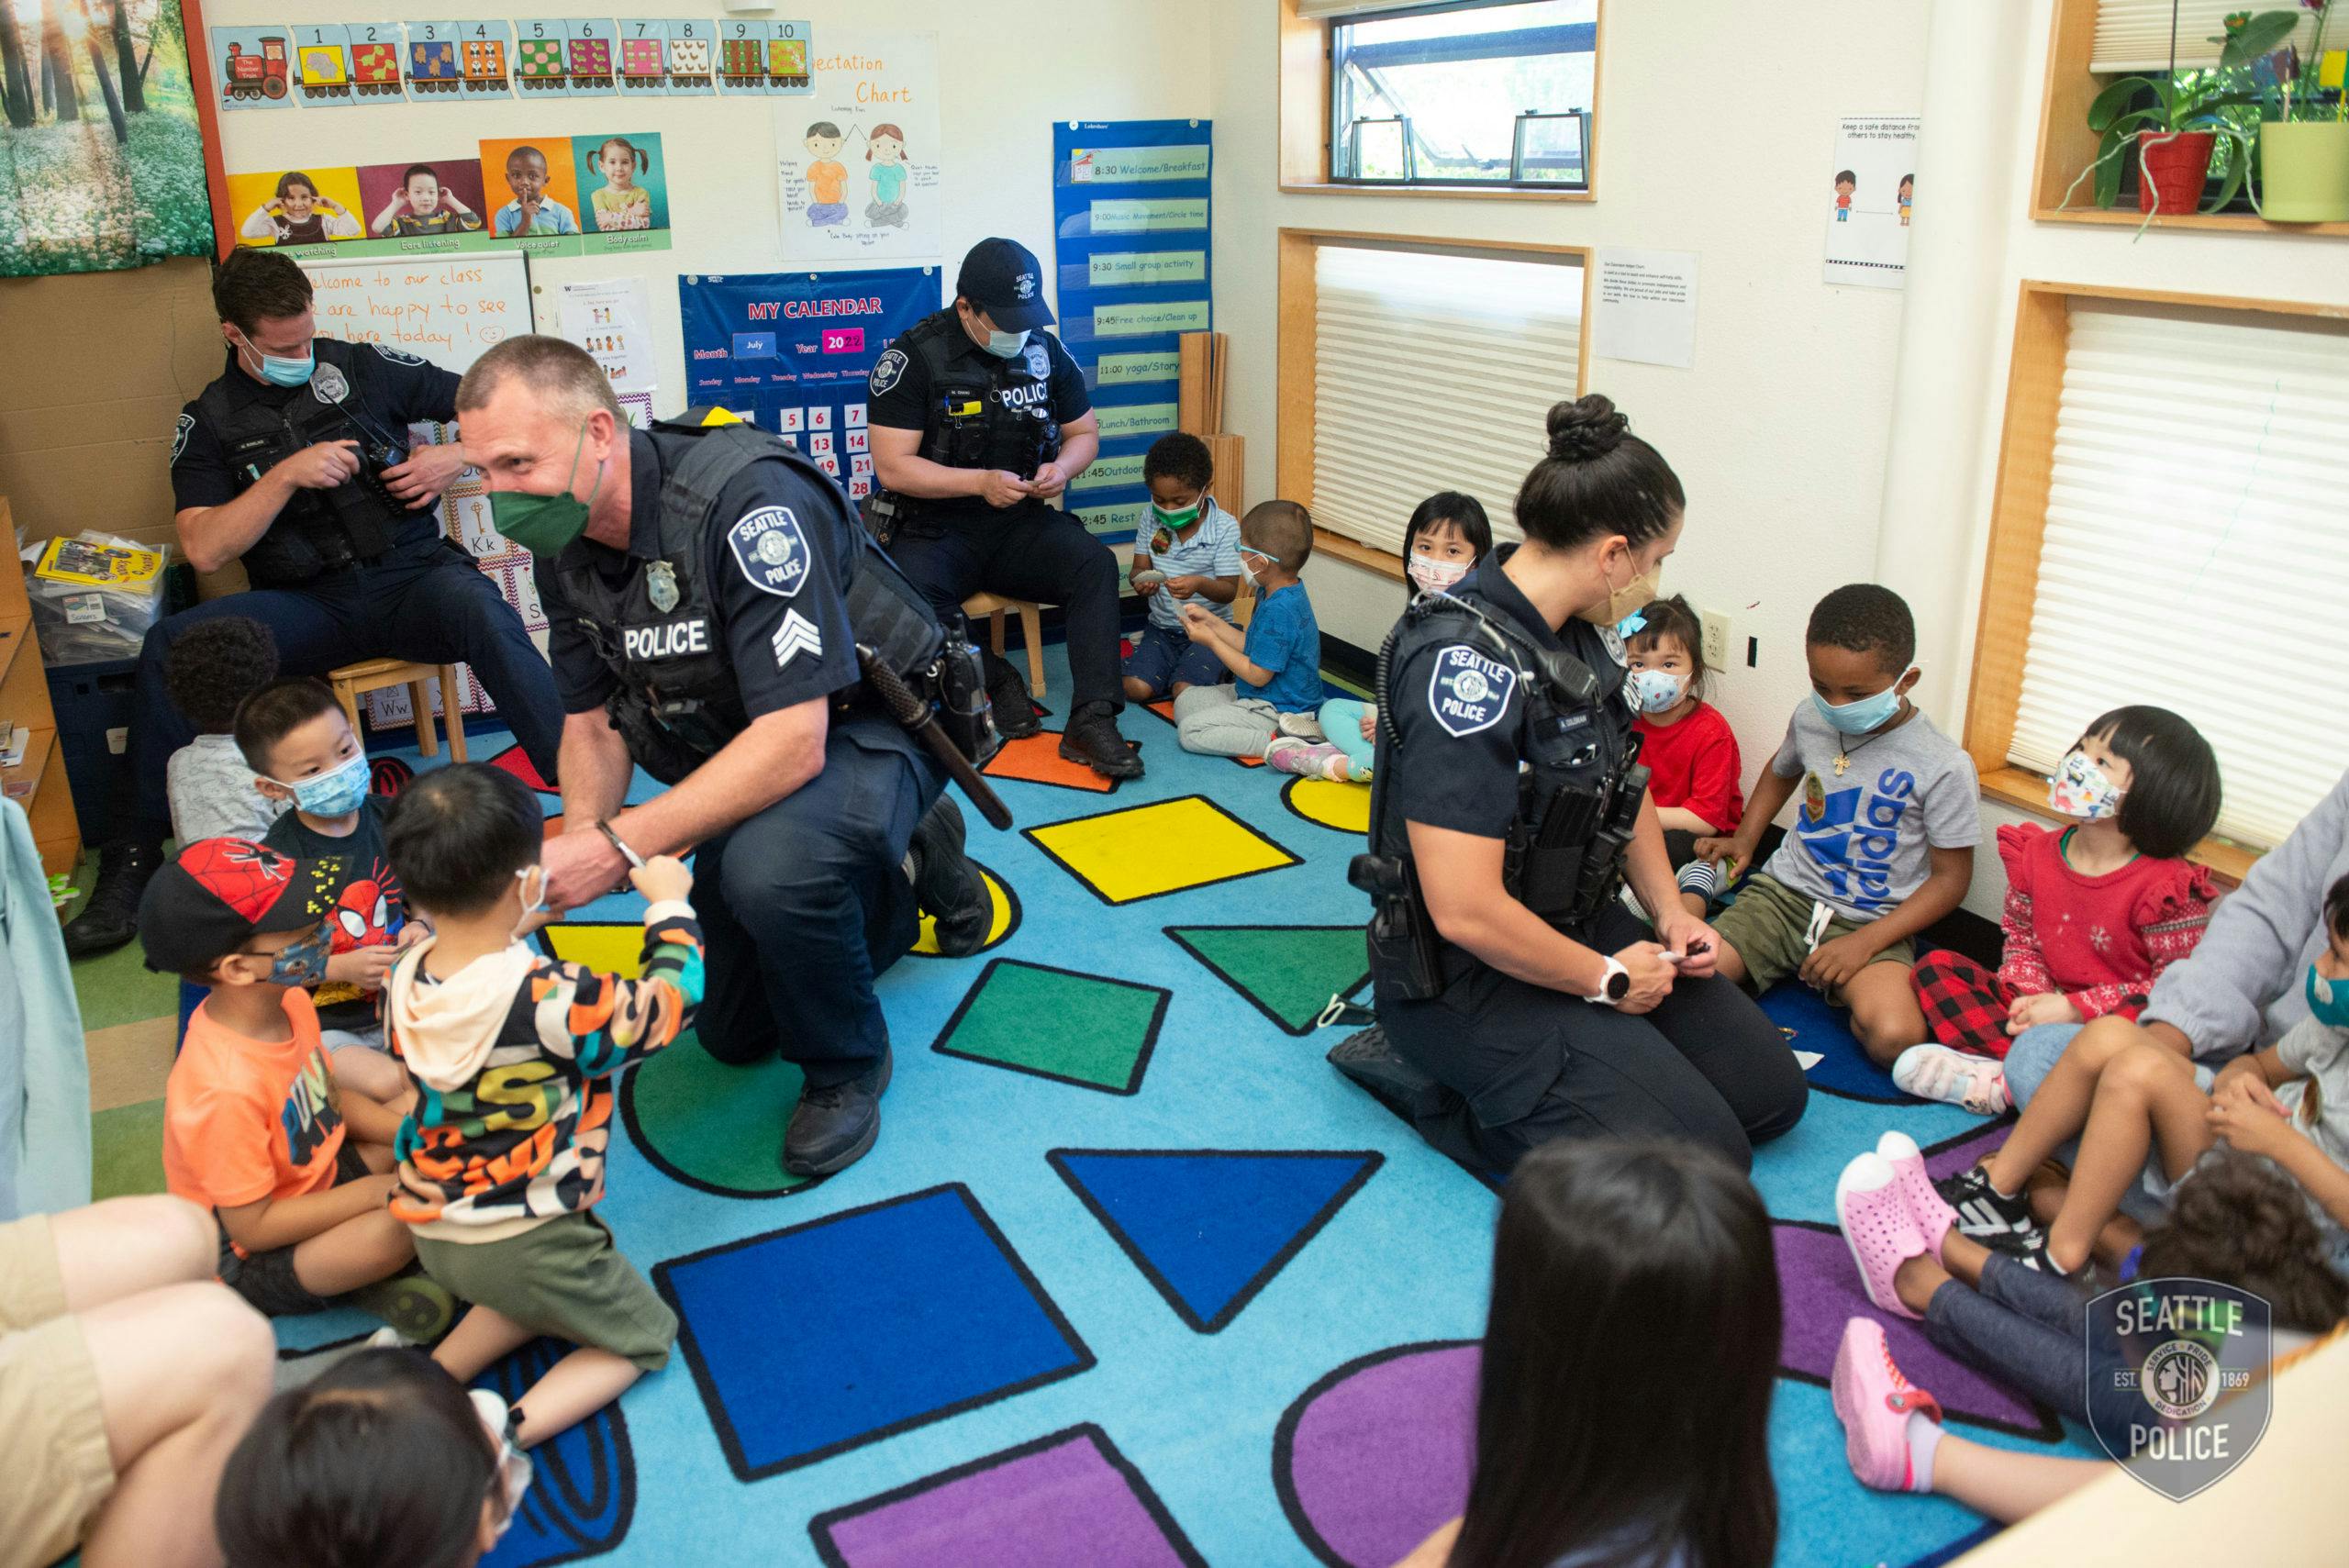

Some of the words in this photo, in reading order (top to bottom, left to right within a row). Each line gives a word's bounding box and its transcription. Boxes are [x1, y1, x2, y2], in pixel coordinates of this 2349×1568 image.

[315, 28, 323, 44] 1
[367, 27, 377, 42] 2
[426, 25, 435, 40] 3
[476, 24, 487, 39] 4
[534, 23, 544, 38] 5
[583, 22, 593, 38] 6
[636, 23, 646, 38] 7
[684, 23, 693, 38] 8
[736, 23, 746, 38] 9
[778, 23, 794, 39] 10
[812, 53, 883, 72] ectation
[855, 81, 912, 104] Chart
[1877, 132, 1891, 140] stay
[1095, 165, 1118, 175] 8:30
[515, 240, 537, 250] Voice
[538, 239, 559, 250] quiet
[607, 235, 628, 246] Body
[628, 234, 649, 243] calm
[295, 246, 337, 258] watching
[1093, 262, 1112, 272] 9:30
[1115, 262, 1137, 271] Small
[1139, 262, 1162, 272] group
[1163, 260, 1195, 270] activity
[373, 271, 390, 287] to
[404, 274, 429, 287] our
[440, 265, 484, 286] class
[327, 304, 358, 317] are
[367, 295, 429, 323] happy
[440, 294, 468, 317] to
[478, 298, 507, 313] see
[748, 302, 781, 321] MY
[784, 296, 884, 318] CALENDAR
[1136, 313, 1186, 324] choice/Clean
[1187, 313, 1197, 321] up
[344, 322, 382, 344] here
[390, 323, 453, 352] today
[694, 348, 728, 360] Month
[746, 340, 763, 350] July
[796, 343, 818, 354] Year
[829, 335, 863, 349] 2022
[698, 378, 722, 387] Sunday
[734, 375, 761, 384] Monday
[771, 373, 797, 383] Tuesday
[802, 371, 838, 380] Wednesday
[841, 369, 870, 378] Thursday
[1100, 366, 1122, 374] 11:00
[788, 414, 796, 427] 5
[816, 413, 824, 425] 6
[852, 410, 859, 422] 7
[814, 438, 829, 450] 13
[850, 435, 865, 448] 14
[855, 459, 871, 473] 21
[852, 482, 868, 495] 28
[740, 511, 787, 541] SEATTLE
[1111, 512, 1136, 524] Rest
[764, 558, 803, 585] POLICE
[624, 619, 709, 660] POLICE
[1449, 651, 1507, 684] SEATTLE
[1441, 697, 1486, 723] POLICE
